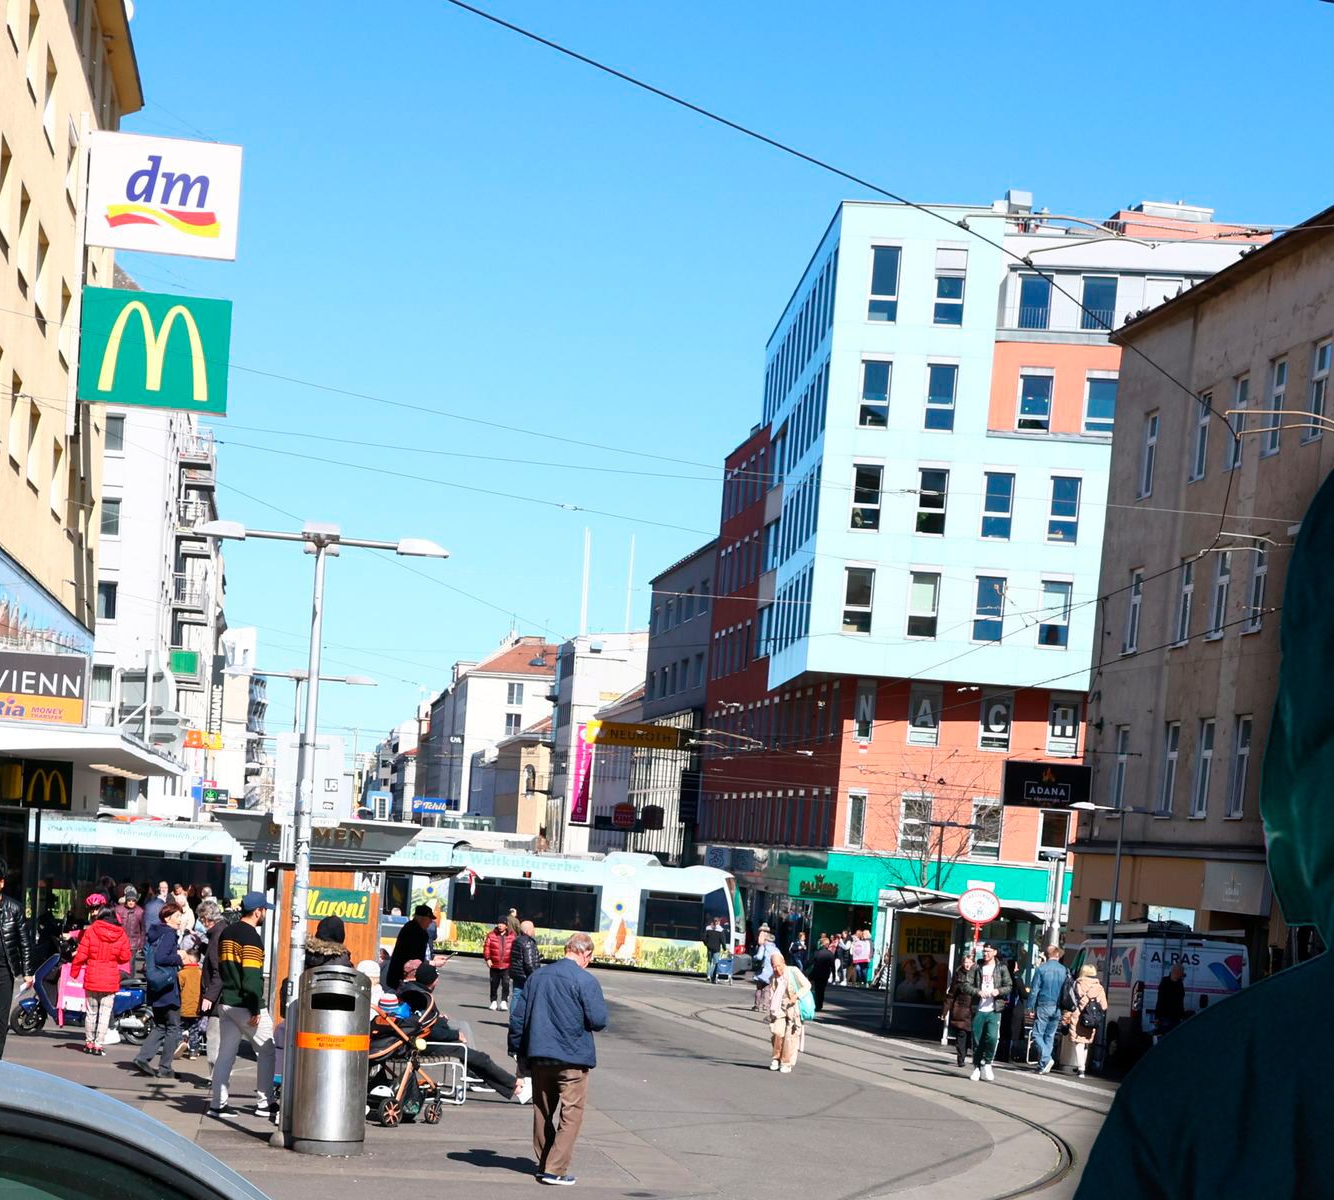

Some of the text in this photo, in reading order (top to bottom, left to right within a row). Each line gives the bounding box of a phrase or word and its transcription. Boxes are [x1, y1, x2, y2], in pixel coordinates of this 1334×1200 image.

[126, 155, 210, 208] dm
[31, 706, 64, 715] MONEY
[211, 684, 223, 734] HUMANIC
[30, 713, 64, 721] TRANSFER
[610, 728, 671, 743] NEUROTH
[1029, 786, 1066, 797] ADANA
